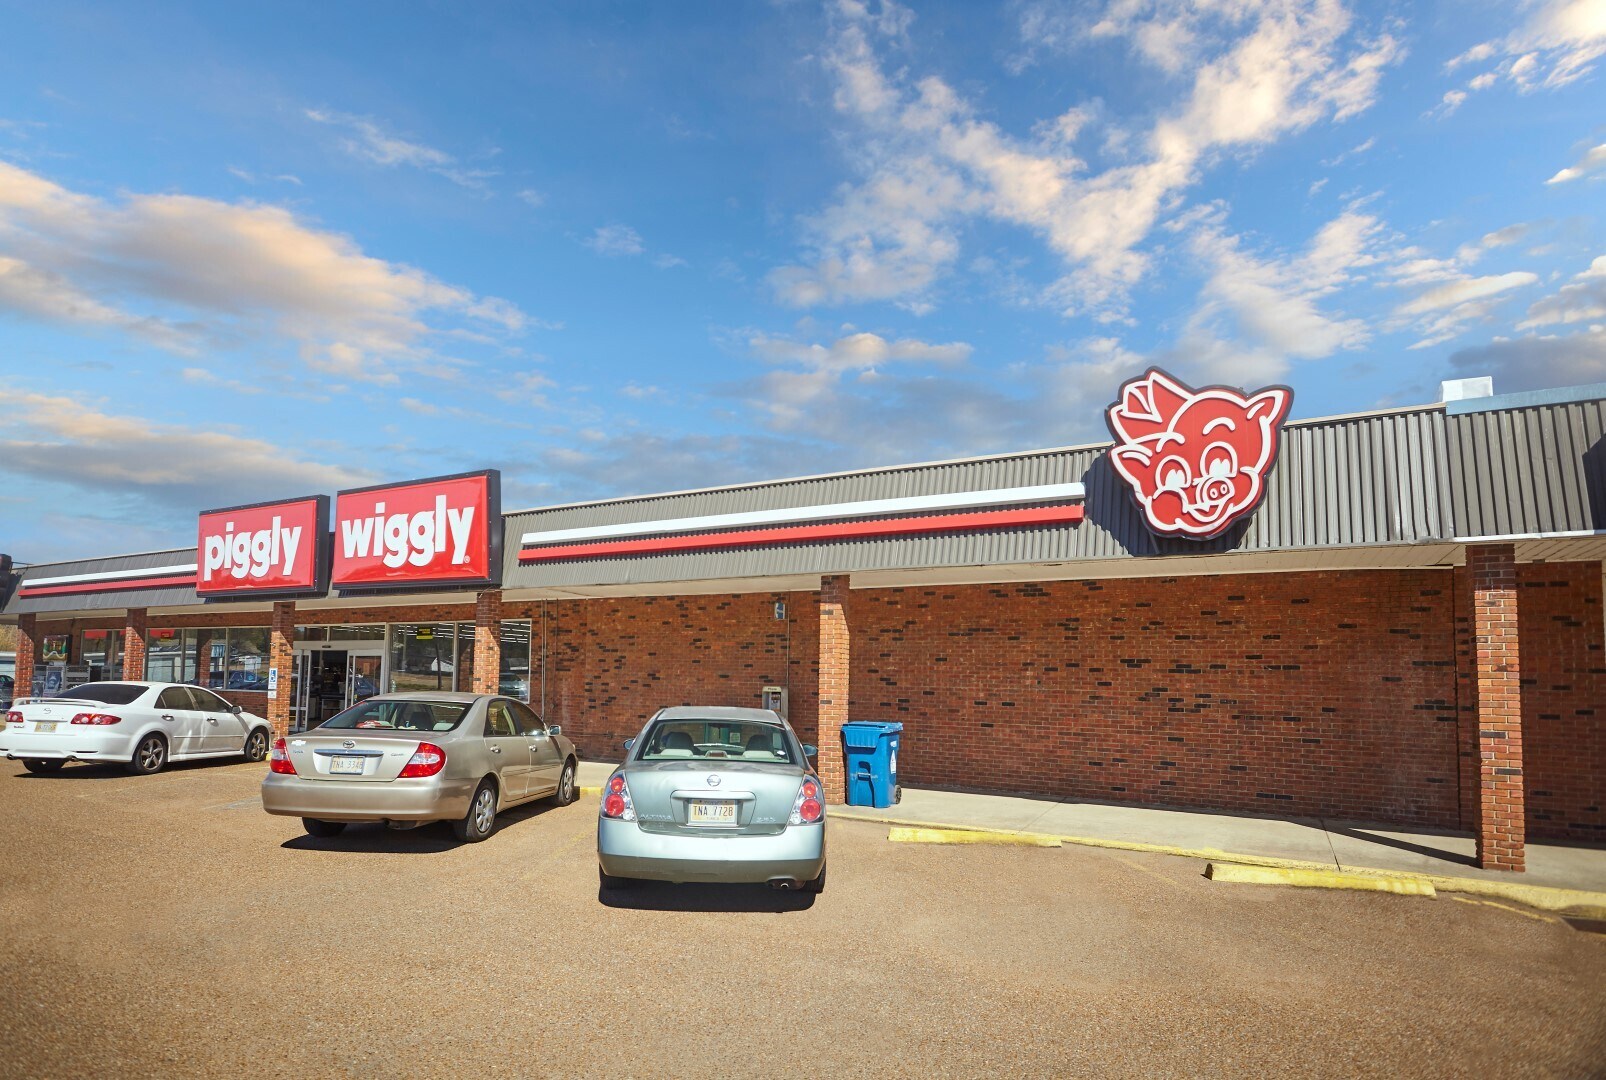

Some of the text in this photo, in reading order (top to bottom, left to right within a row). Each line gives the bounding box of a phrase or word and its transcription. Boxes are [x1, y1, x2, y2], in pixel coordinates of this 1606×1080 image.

[203, 494, 475, 582] piggly wiggly
[693, 805, 708, 816] TNA
